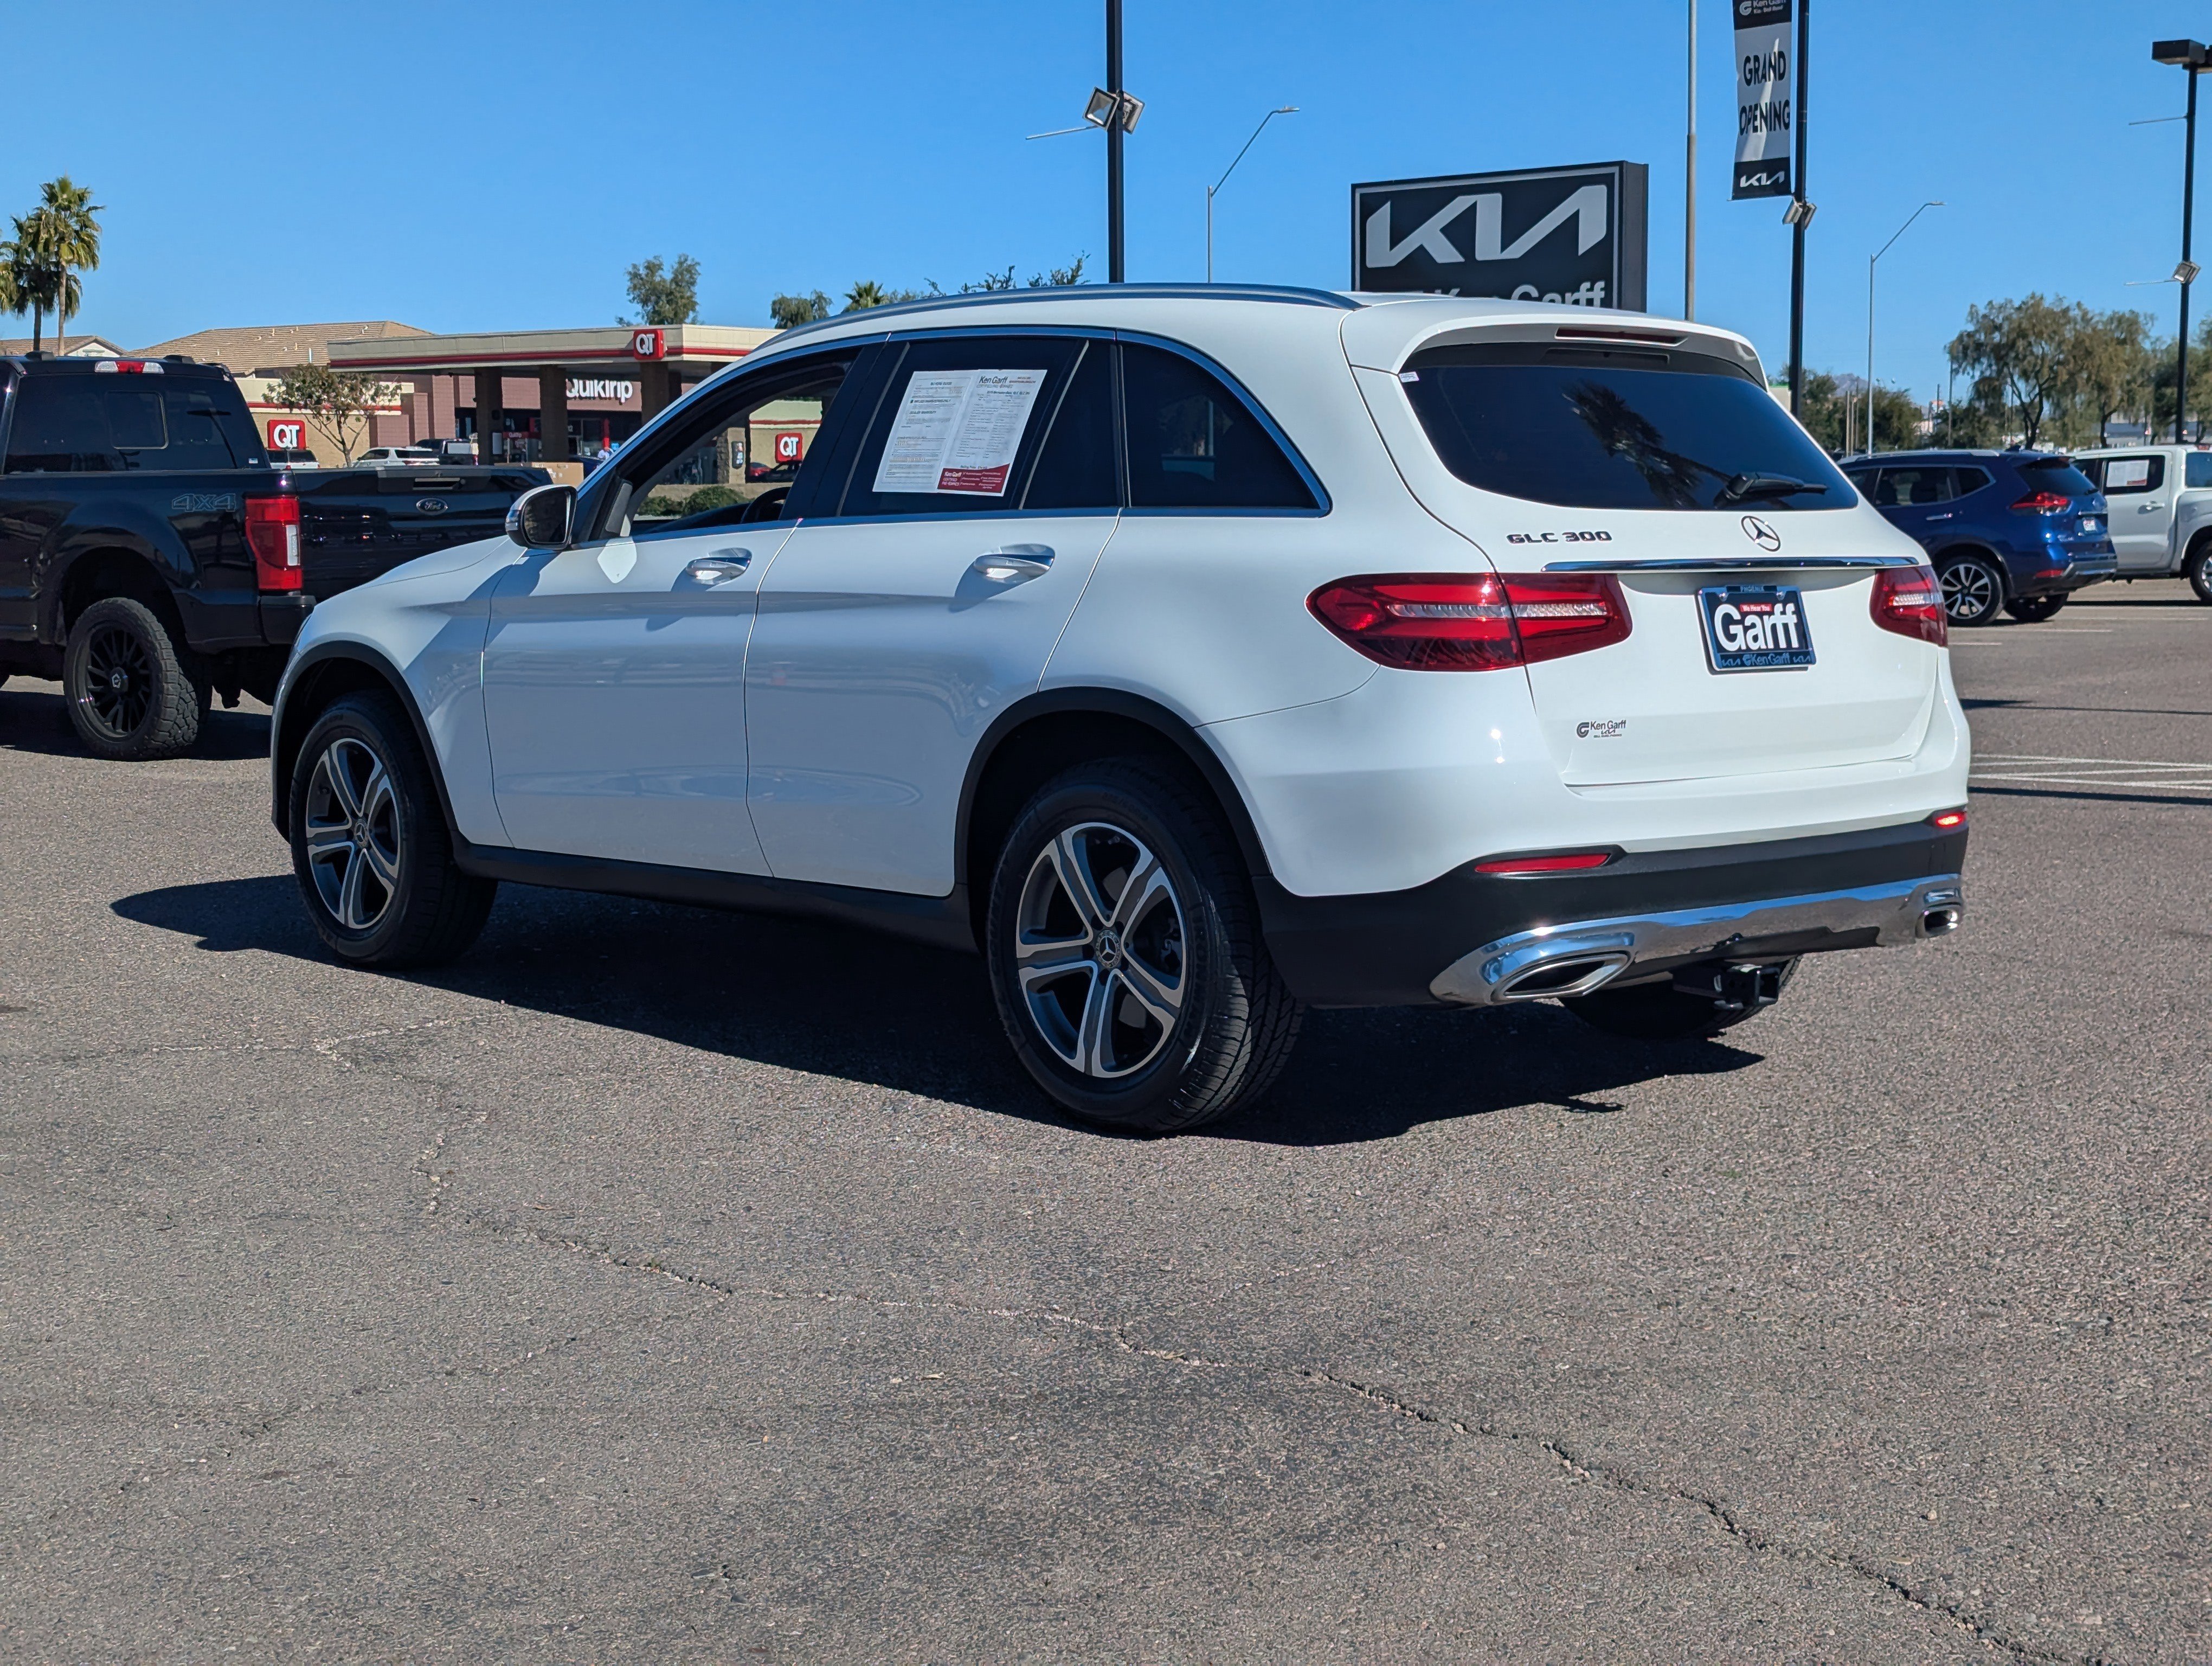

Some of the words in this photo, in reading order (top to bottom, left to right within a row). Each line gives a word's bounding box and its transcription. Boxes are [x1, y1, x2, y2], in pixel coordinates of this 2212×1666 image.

[1743, 50, 1786, 86] GRAND
[1739, 99, 1790, 136] OPENING
[1740, 171, 1785, 188] KIA
[1366, 184, 1607, 268] KIA
[636, 333, 655, 355] QT
[979, 376, 993, 384] Ken
[273, 424, 300, 450] QT
[780, 436, 799, 457] QT
[1506, 532, 1559, 544] GLC
[1561, 530, 1612, 543] 300
[1714, 603, 1799, 651] Garff
[1752, 653, 1769, 665] Ken
[1590, 720, 1606, 731] Ken
[1606, 719, 1626, 729] Garff
